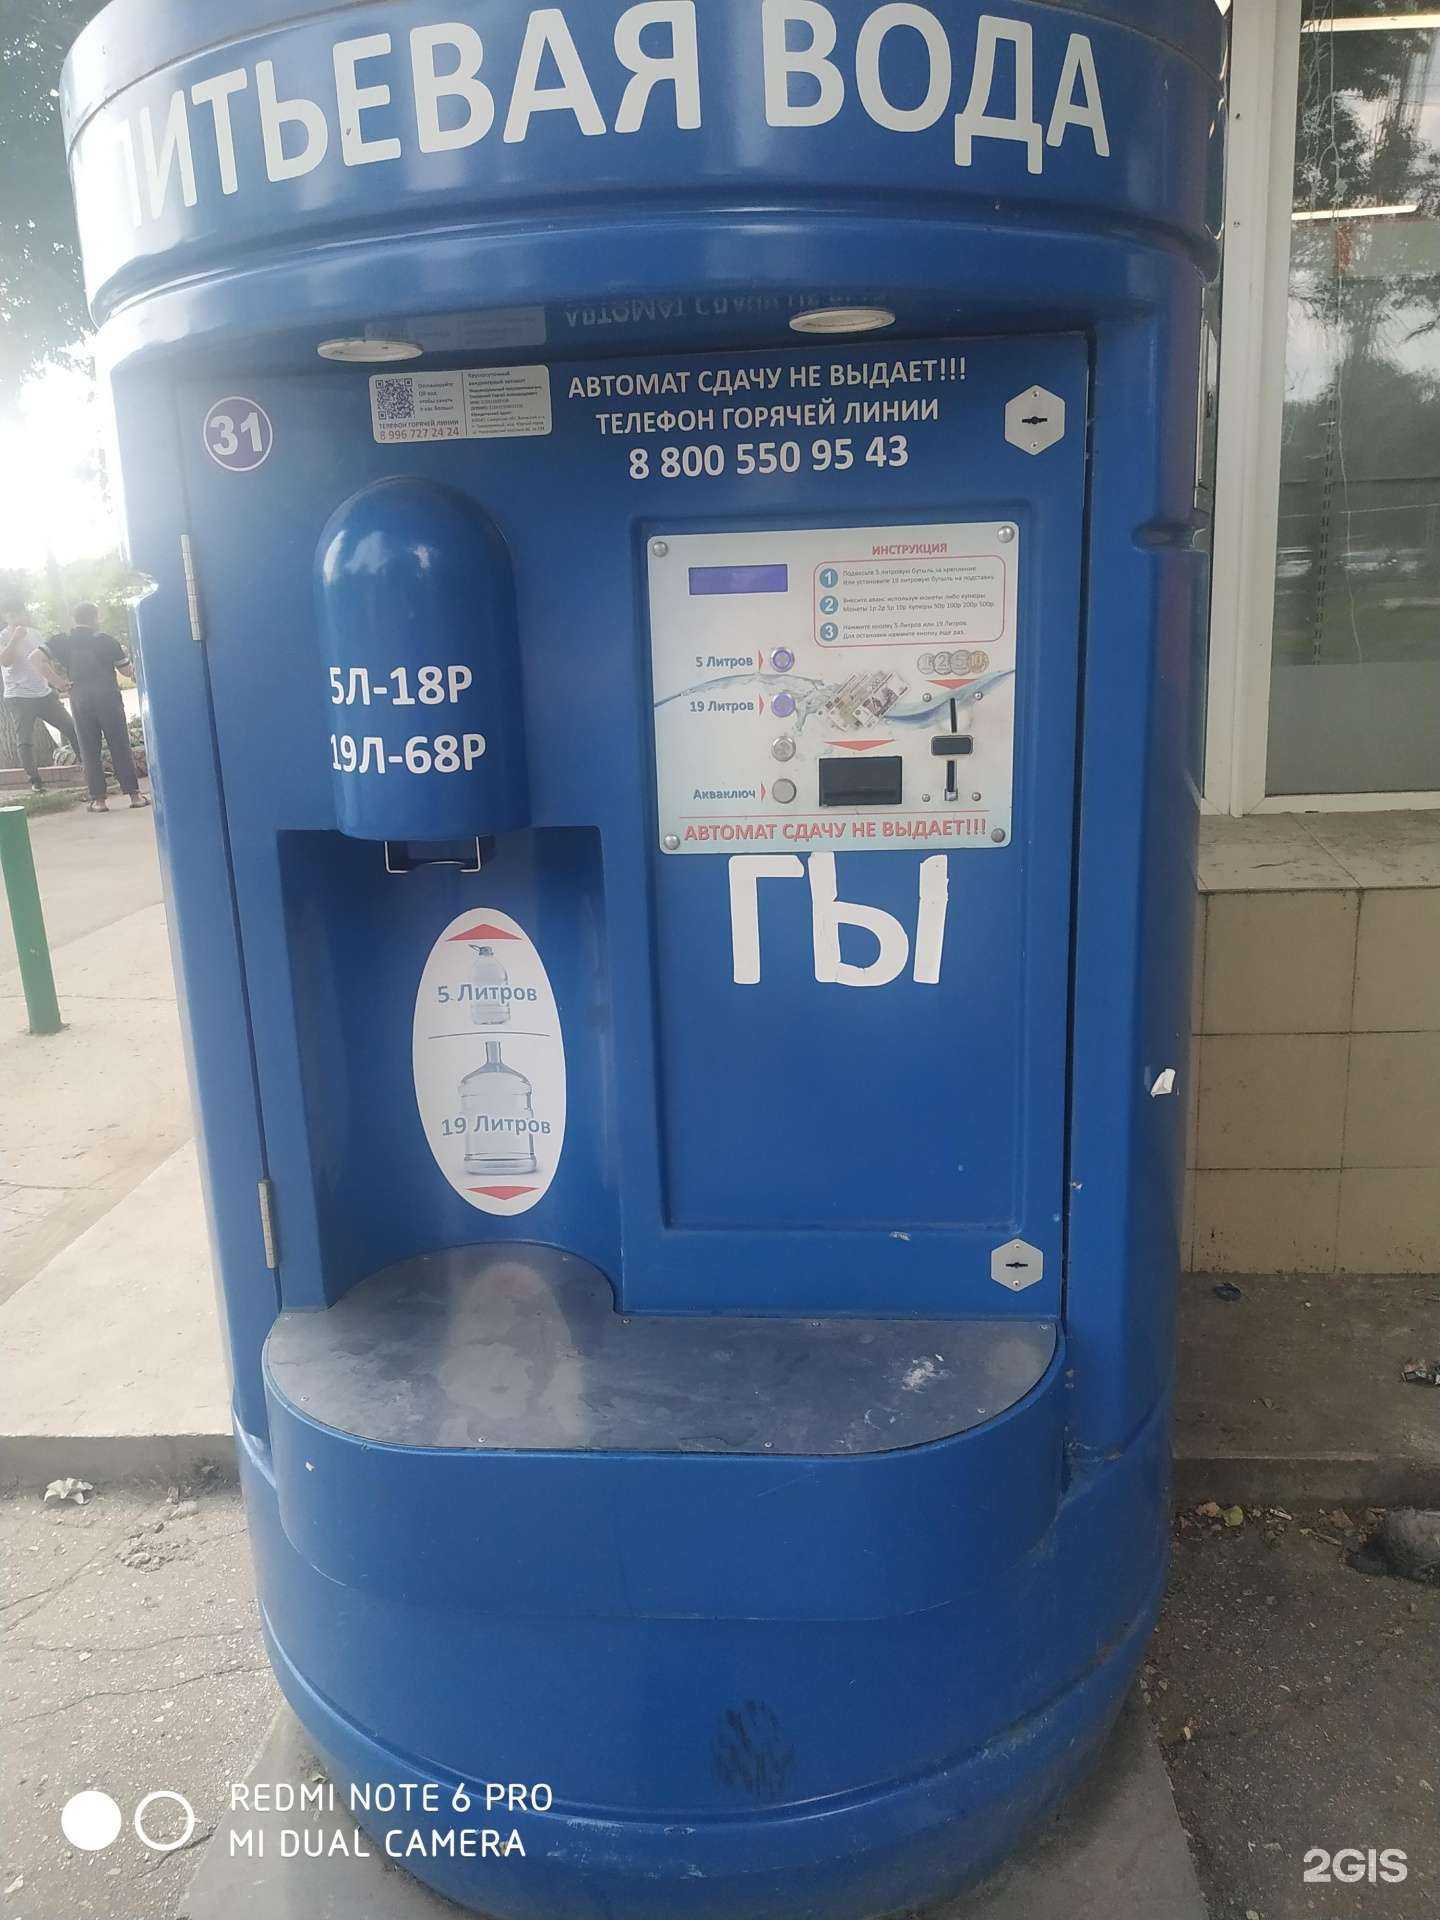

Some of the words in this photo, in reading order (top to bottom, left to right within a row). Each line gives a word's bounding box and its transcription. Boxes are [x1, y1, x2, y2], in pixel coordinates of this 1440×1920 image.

[762, 0, 1110, 175] ВОДА
[567, 371, 691, 399] АВТОМАТ
[697, 366, 782, 396] СДАЧУ
[789, 363, 822, 388] НЕ
[829, 356, 968, 389] ВЫДАЕТ!!!
[595, 408, 714, 435] ТЕЛЕФОН
[722, 398, 836, 431] ГОРЯЧЕЙ
[842, 397, 939, 425] ЛИНИИ
[210, 412, 263, 455] 31
[388, 430, 408, 440] 996
[410, 429, 428, 438] 727
[432, 428, 443, 437] 24
[447, 427, 459, 437] 24
[629, 447, 650, 480] 8
[660, 444, 725, 478] 800
[736, 440, 800, 475] 550
[811, 437, 854, 471] 95
[865, 434, 909, 468] 43
[872, 543, 948, 556] ИНСТРУКЦИЯ
[825, 570, 832, 585] 1
[824, 599, 834, 612] 2
[825, 625, 833, 639] 3
[695, 656, 703, 667] 5
[706, 655, 754, 671] Литров
[329, 665, 473, 706] 5Л-18Р
[689, 700, 706, 712] 19
[709, 698, 754, 714] Литров
[330, 733, 487, 774] 19Л-68Р
[693, 787, 756, 801] Акваключ
[684, 823, 778, 842] АВТОМАТ
[782, 821, 847, 842] СДАЧУ
[851, 821, 876, 837] НЕ
[882, 817, 987, 839] ВЫДАЕТ!!!
[728, 851, 950, 987] ГЫ
[437, 985, 450, 1003] 5
[457, 983, 538, 1005] Литров
[441, 1116, 467, 1136] 19
[474, 1115, 551, 1136] Литров
